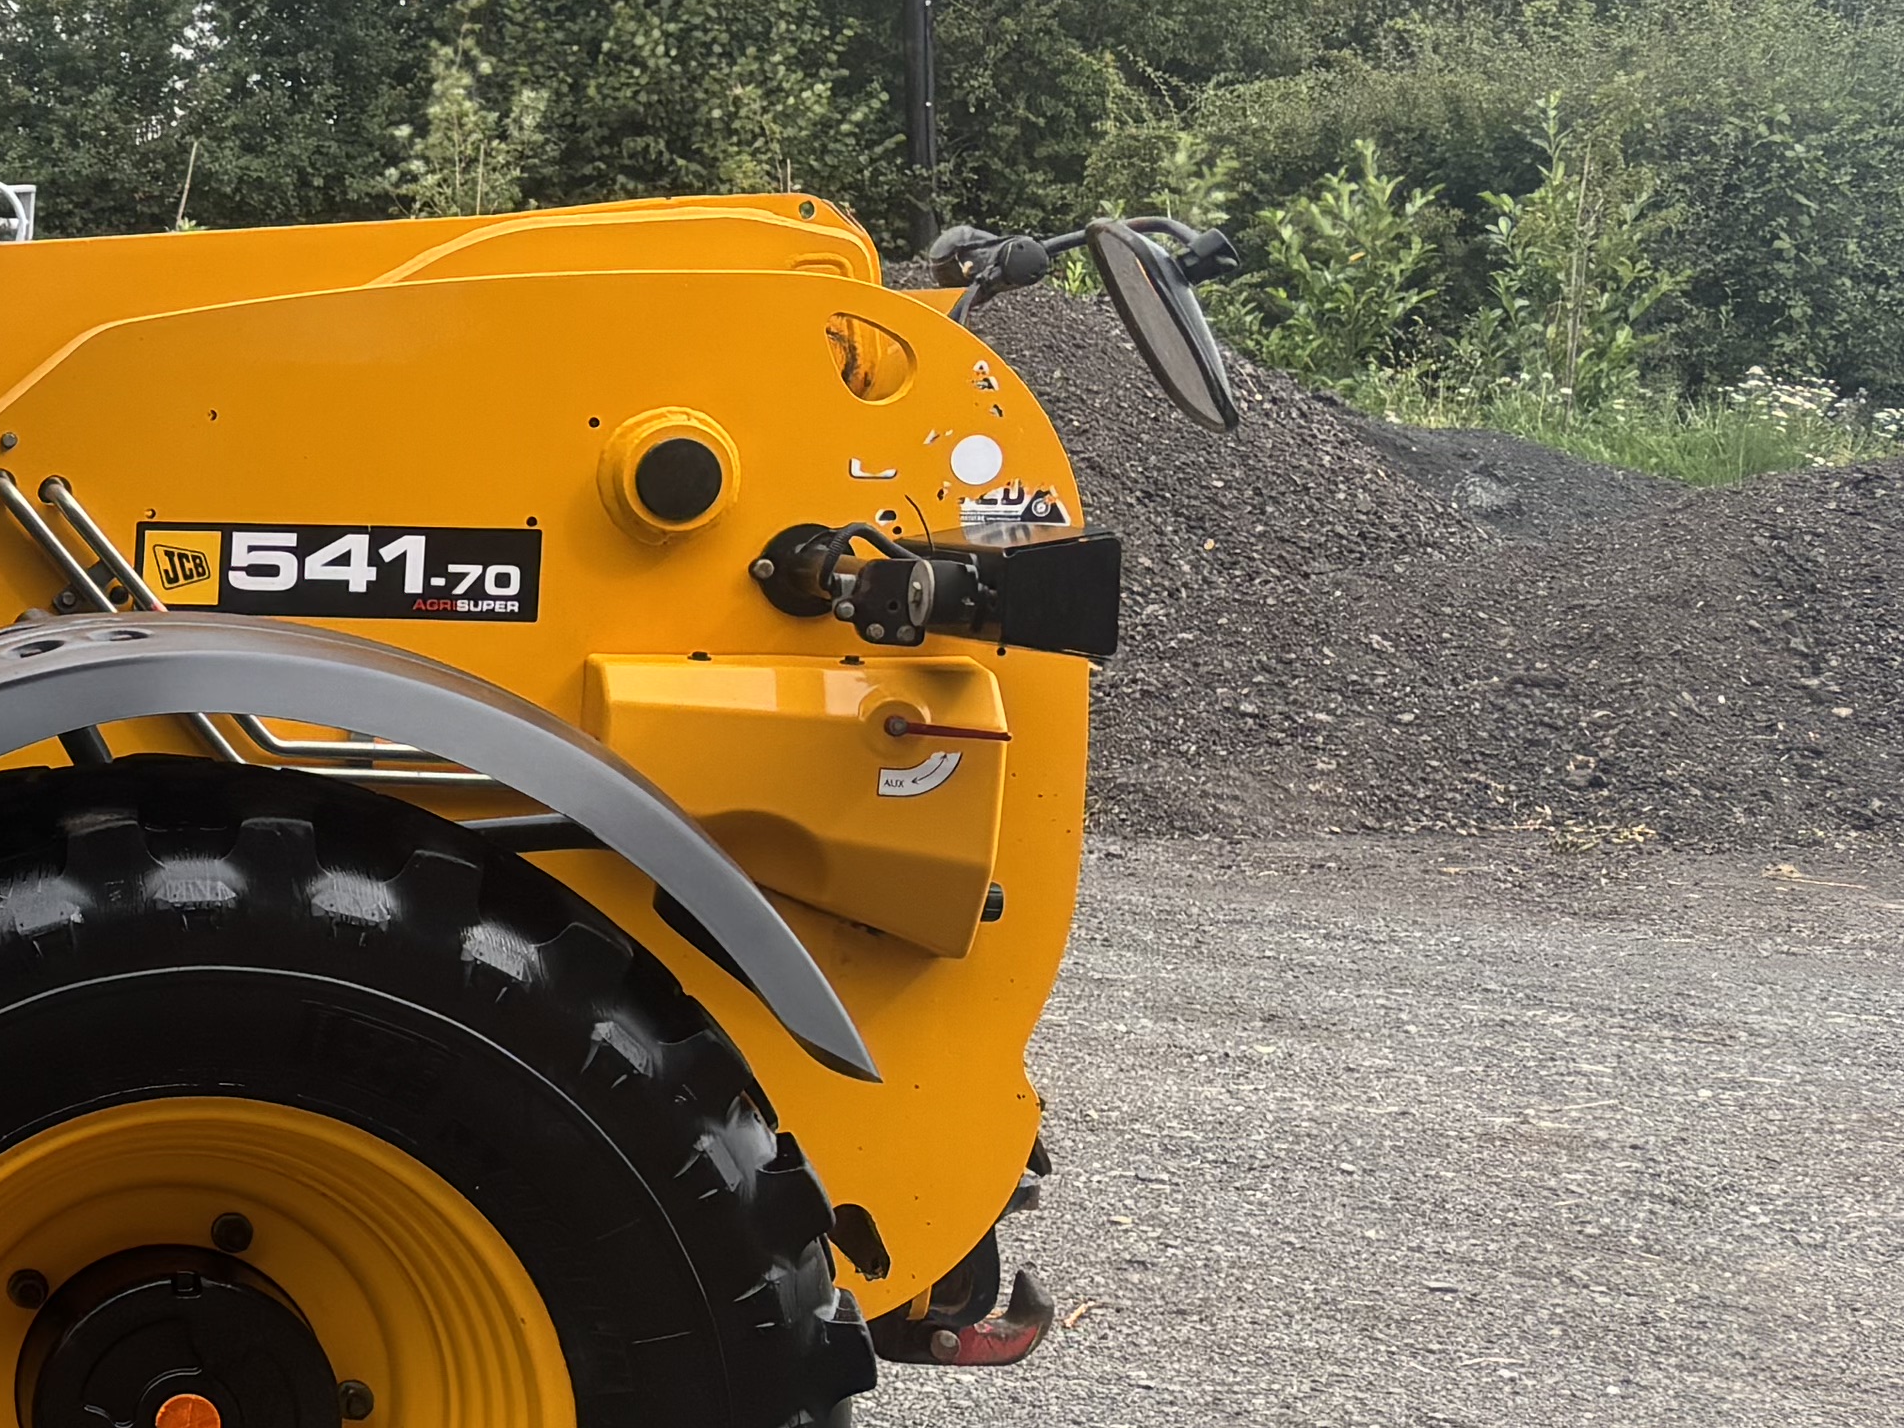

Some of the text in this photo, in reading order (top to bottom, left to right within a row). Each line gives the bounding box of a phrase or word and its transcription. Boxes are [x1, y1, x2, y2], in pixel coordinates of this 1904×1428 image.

[163, 548, 208, 585] JCB
[228, 531, 521, 596] 541-70
[413, 598, 520, 613] AGRISUPER
[884, 779, 904, 788] AUX
